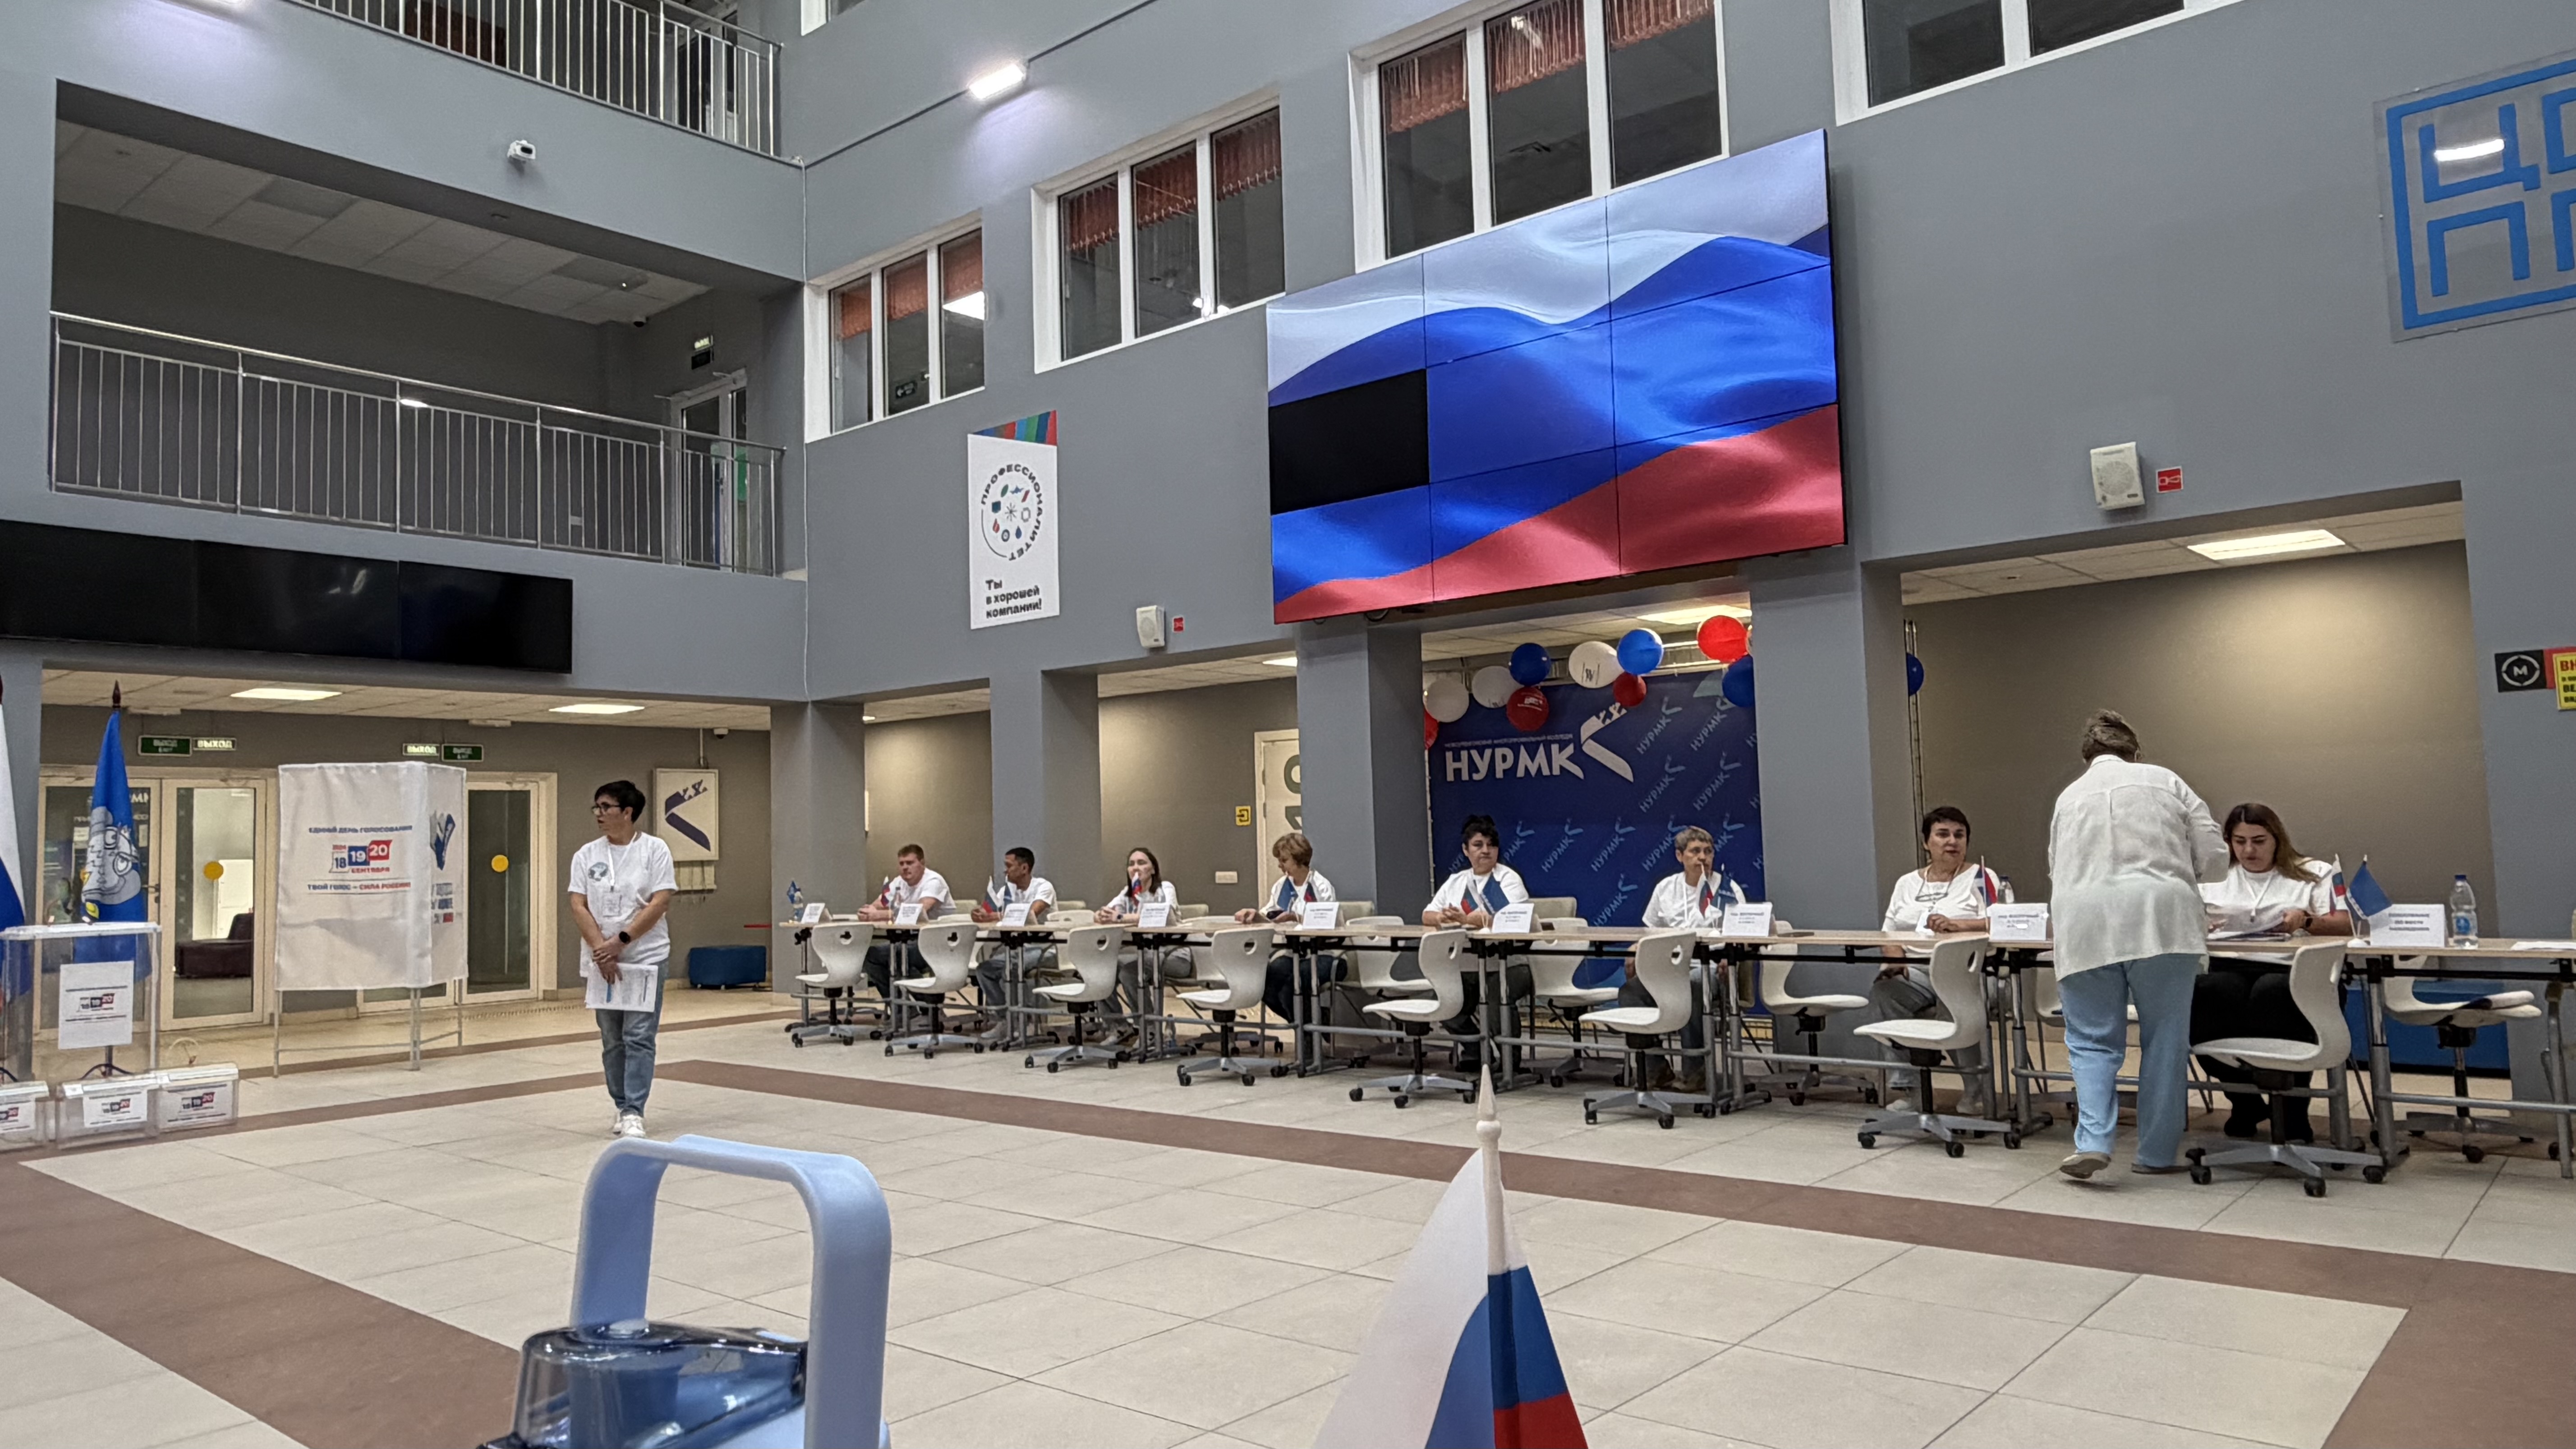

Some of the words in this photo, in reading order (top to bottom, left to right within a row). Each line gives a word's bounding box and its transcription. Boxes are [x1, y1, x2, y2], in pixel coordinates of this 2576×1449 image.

[981, 464, 1043, 561] ПРОФЕССИОНАЛИТЕТ
[985, 579, 1003, 590] Ты
[986, 596, 992, 605] в
[993, 585, 1040, 604] хорошей
[986, 598, 1042, 619] компании!
[197, 740, 232, 749] ВЫХОД
[1636, 716, 1671, 754] НУРМК
[1690, 710, 1728, 751] НУРМК
[1445, 743, 1584, 782] НУРМК
[1639, 776, 1675, 813] НУРМК
[1693, 772, 1730, 811] НУРМК
[335, 857, 347, 869] 18
[350, 851, 366, 862] 19
[369, 844, 388, 856] 20
[1541, 835, 1575, 873] НУРМК
[1591, 833, 1625, 872] НУРМК
[202, 1094, 213, 1102] 20
